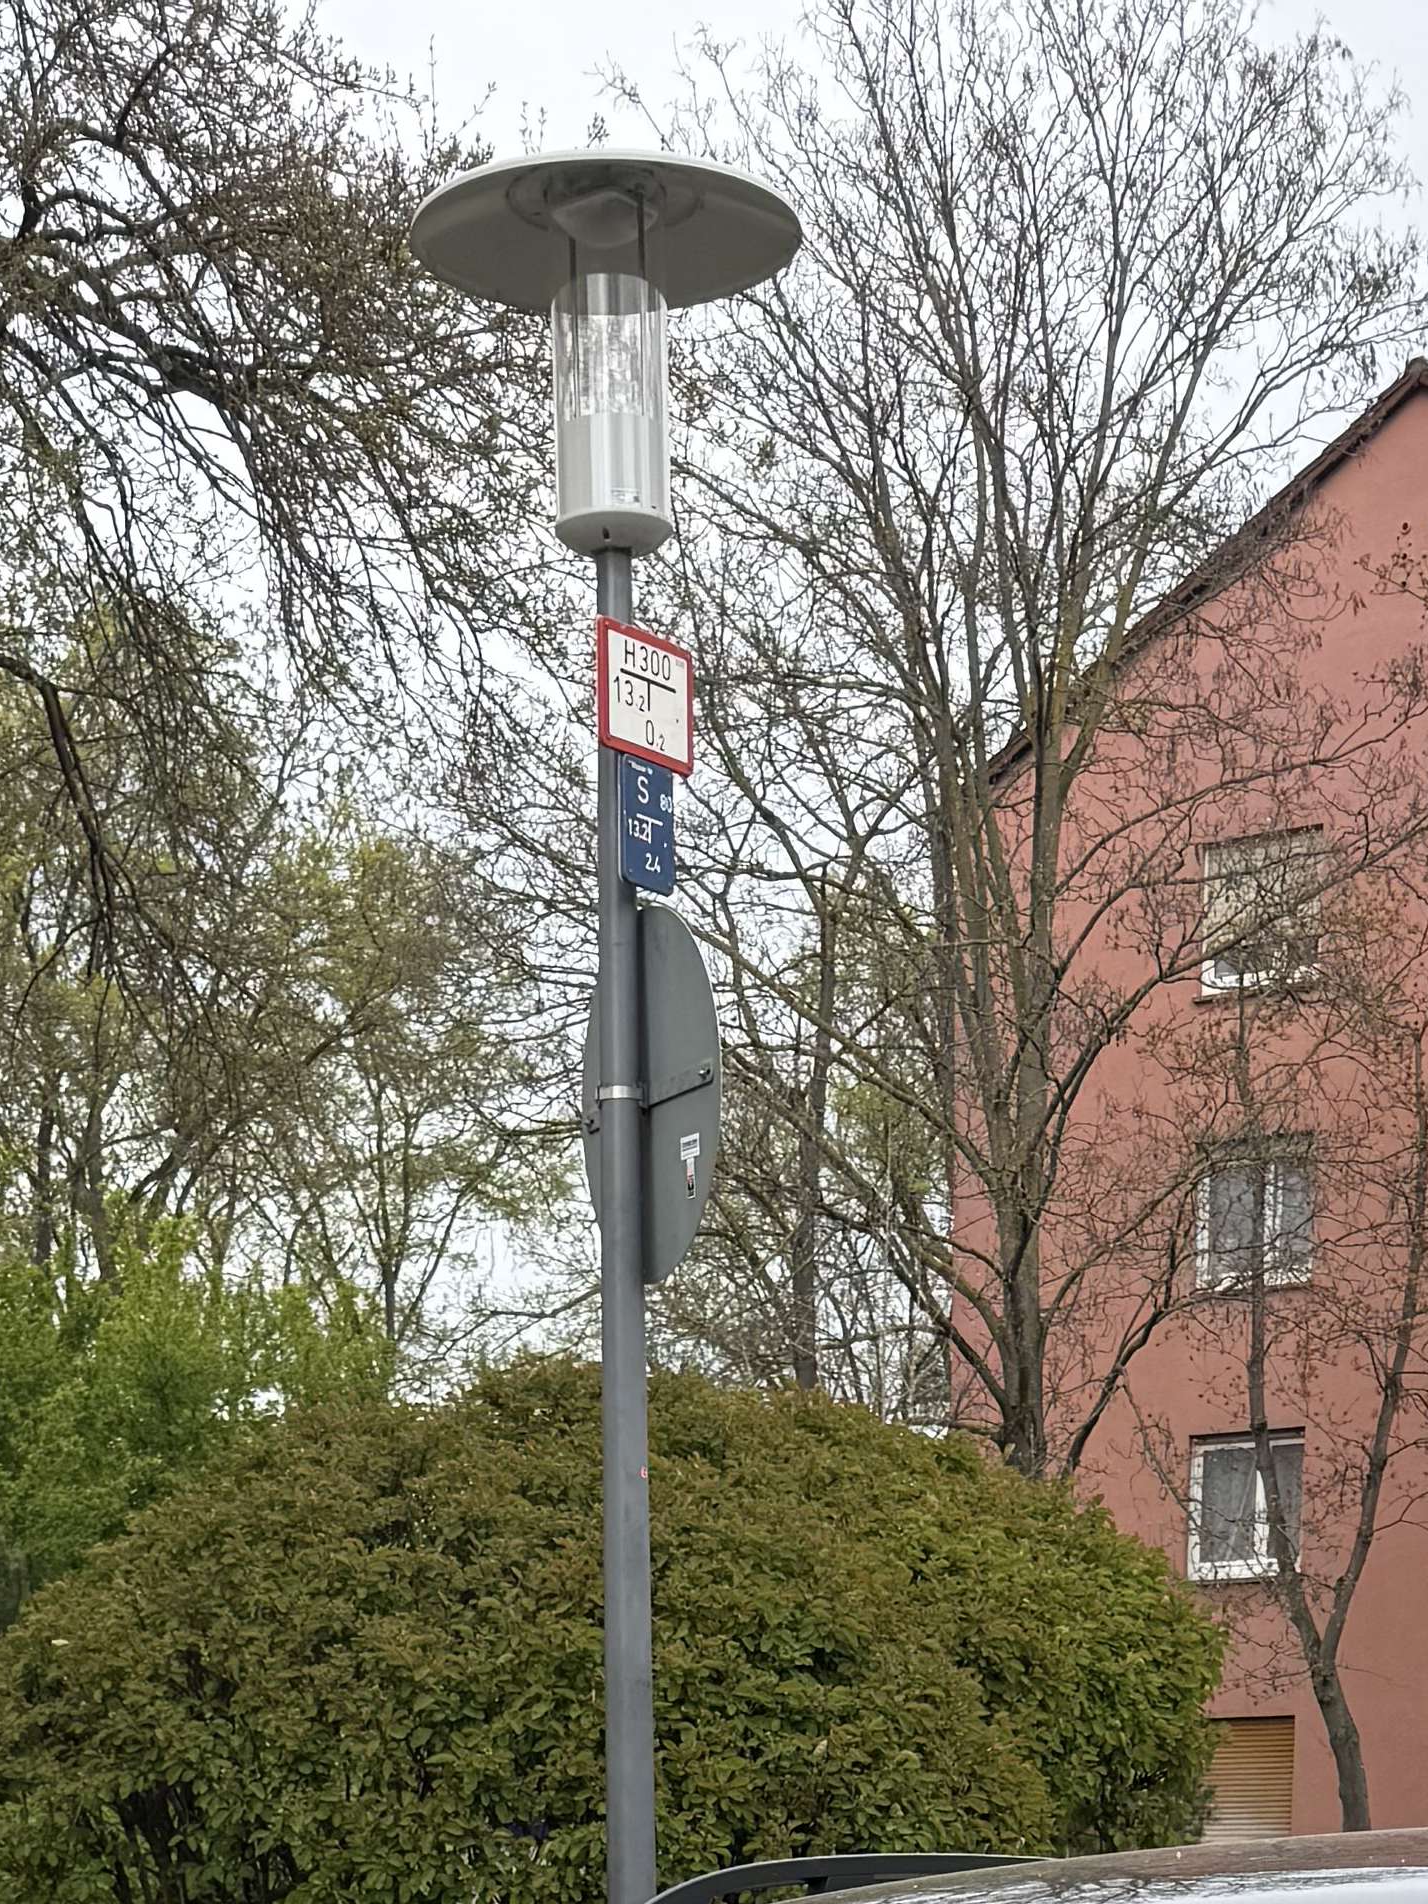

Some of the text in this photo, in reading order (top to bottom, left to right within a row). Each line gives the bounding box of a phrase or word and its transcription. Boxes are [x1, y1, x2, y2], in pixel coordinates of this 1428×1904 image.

[624, 639, 671, 681] H300
[613, 675, 646, 713] 13.2
[645, 719, 666, 752] 0.2
[637, 775, 650, 805] S
